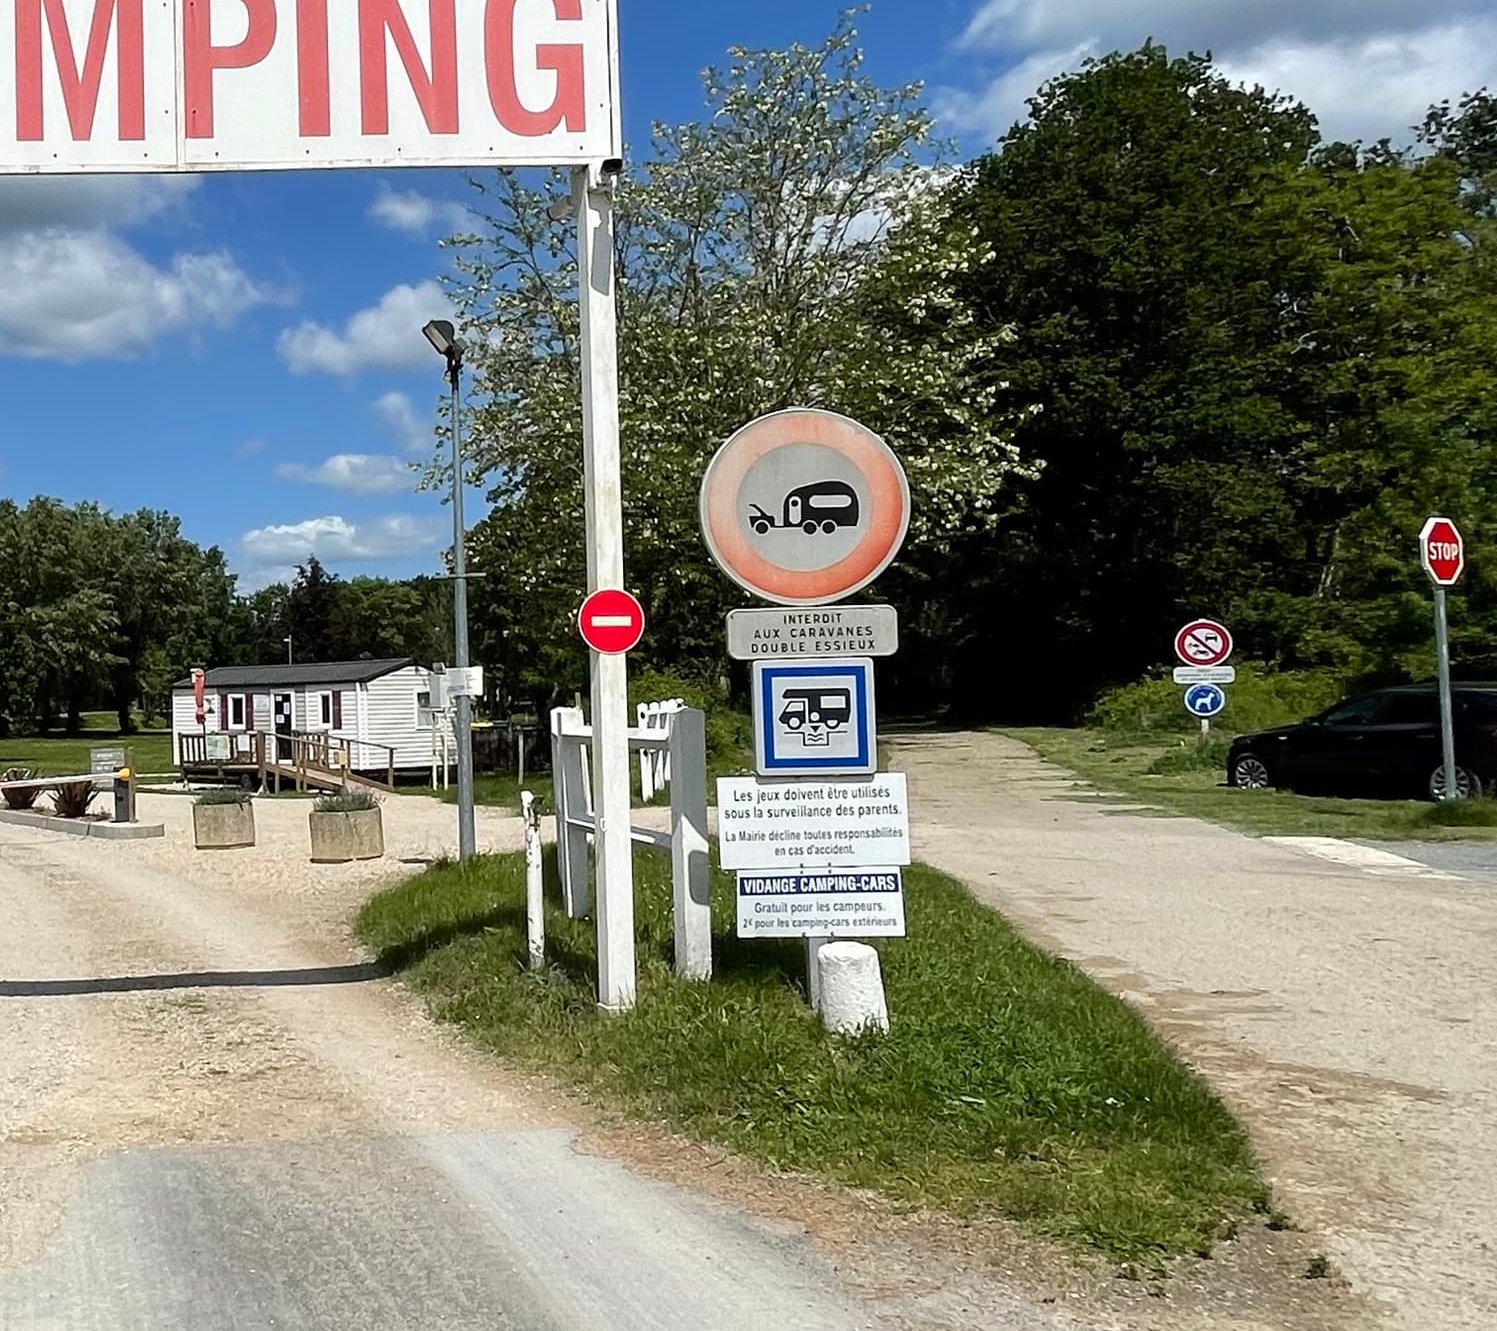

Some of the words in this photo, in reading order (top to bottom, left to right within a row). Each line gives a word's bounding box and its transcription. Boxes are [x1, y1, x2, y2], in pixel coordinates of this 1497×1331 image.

[1429, 541, 1459, 560] STOP
[783, 613, 842, 624] INTERDIT
[754, 629, 780, 639] AUX
[790, 626, 873, 638] CARAVANES
[751, 642, 805, 653] DOUBLE
[815, 640, 876, 651] ESSIEUX
[733, 789, 753, 802] Les
[757, 789, 780, 805] jeux
[784, 788, 824, 801] doivent
[827, 787, 848, 799] être
[851, 785, 890, 799] utilisés
[724, 809, 751, 819] sous
[753, 806, 763, 818] la
[767, 804, 832, 819] surveillance
[836, 804, 855, 816] des
[858, 803, 902, 819] parents.
[725, 831, 736, 842] La
[739, 830, 766, 841] Mairie
[768, 830, 801, 841] décline
[804, 830, 832, 840] toutes
[834, 827, 903, 841] responsabilités
[774, 847, 786, 856] en
[788, 847, 804, 856] cas
[744, 878, 797, 894] VIDANGE
[800, 875, 896, 892] CAMPING-CARS
[754, 902, 788, 913] Gratuit
[791, 904, 813, 915] pour
[816, 901, 830, 911] les
[833, 902, 886, 913] campeurs.
[754, 919, 775, 930] pour
[777, 918, 790, 927] les
[792, 918, 850, 929] camping-cars
[853, 917, 897, 926] extérieurs
